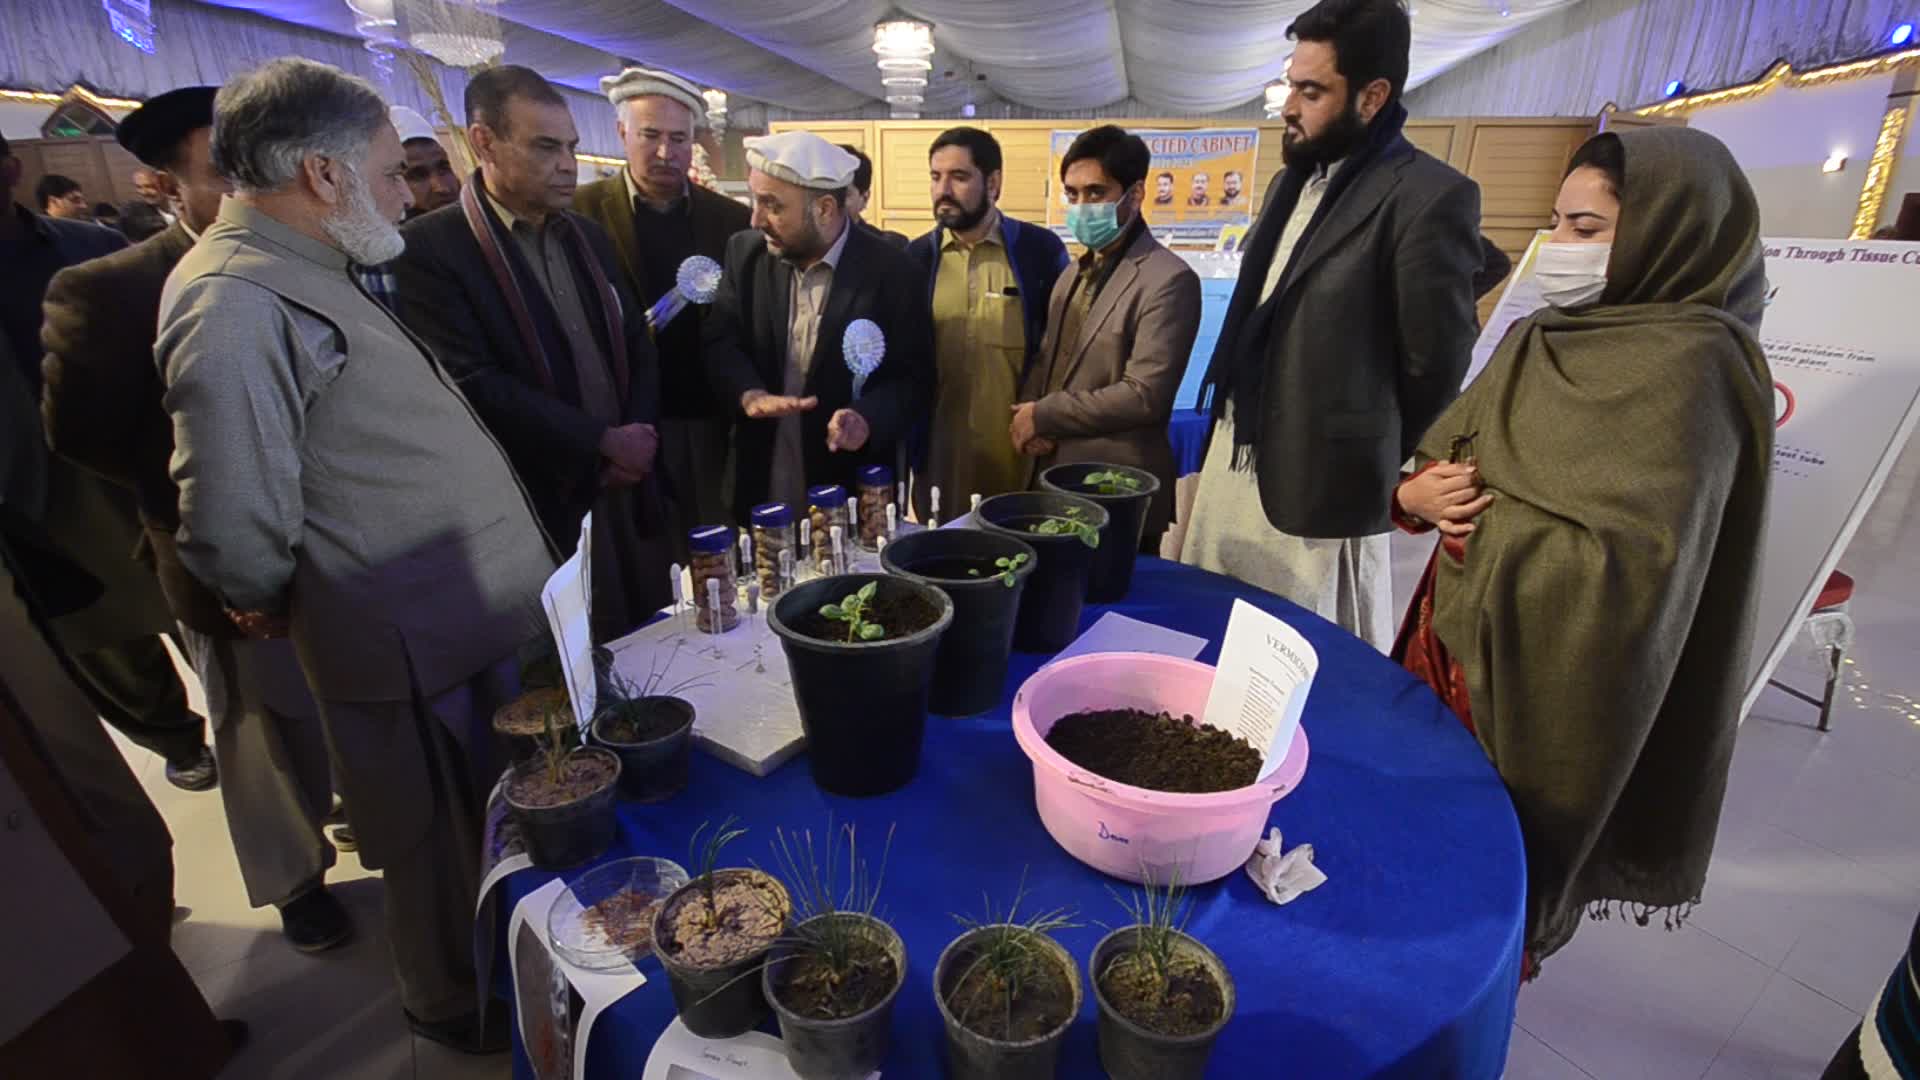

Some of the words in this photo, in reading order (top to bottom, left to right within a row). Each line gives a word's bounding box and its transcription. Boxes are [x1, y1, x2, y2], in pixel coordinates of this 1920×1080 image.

[1191, 136, 1250, 153] CABINET
[1784, 246, 1846, 263] Through
[1850, 248, 1899, 263] Tissue
